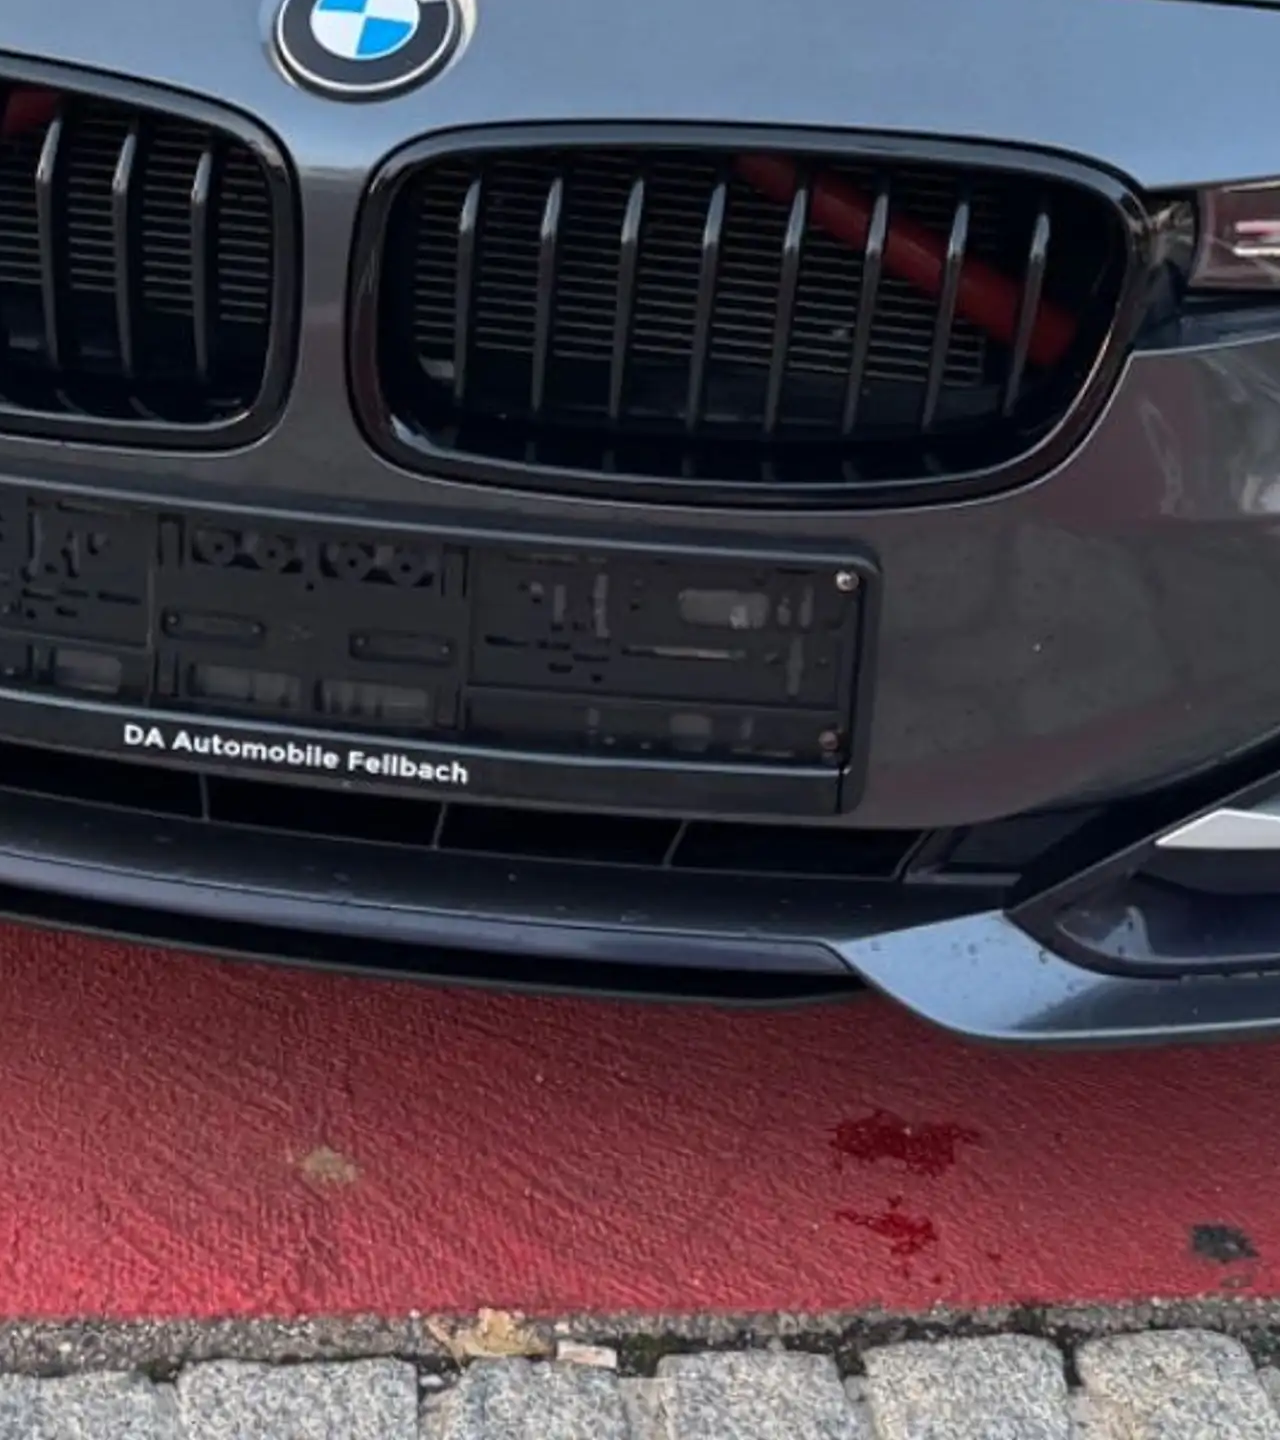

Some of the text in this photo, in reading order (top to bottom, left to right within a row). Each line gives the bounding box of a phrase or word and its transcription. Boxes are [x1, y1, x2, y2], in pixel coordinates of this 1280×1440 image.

[123, 723, 469, 785] DA Automobile Fellbach
